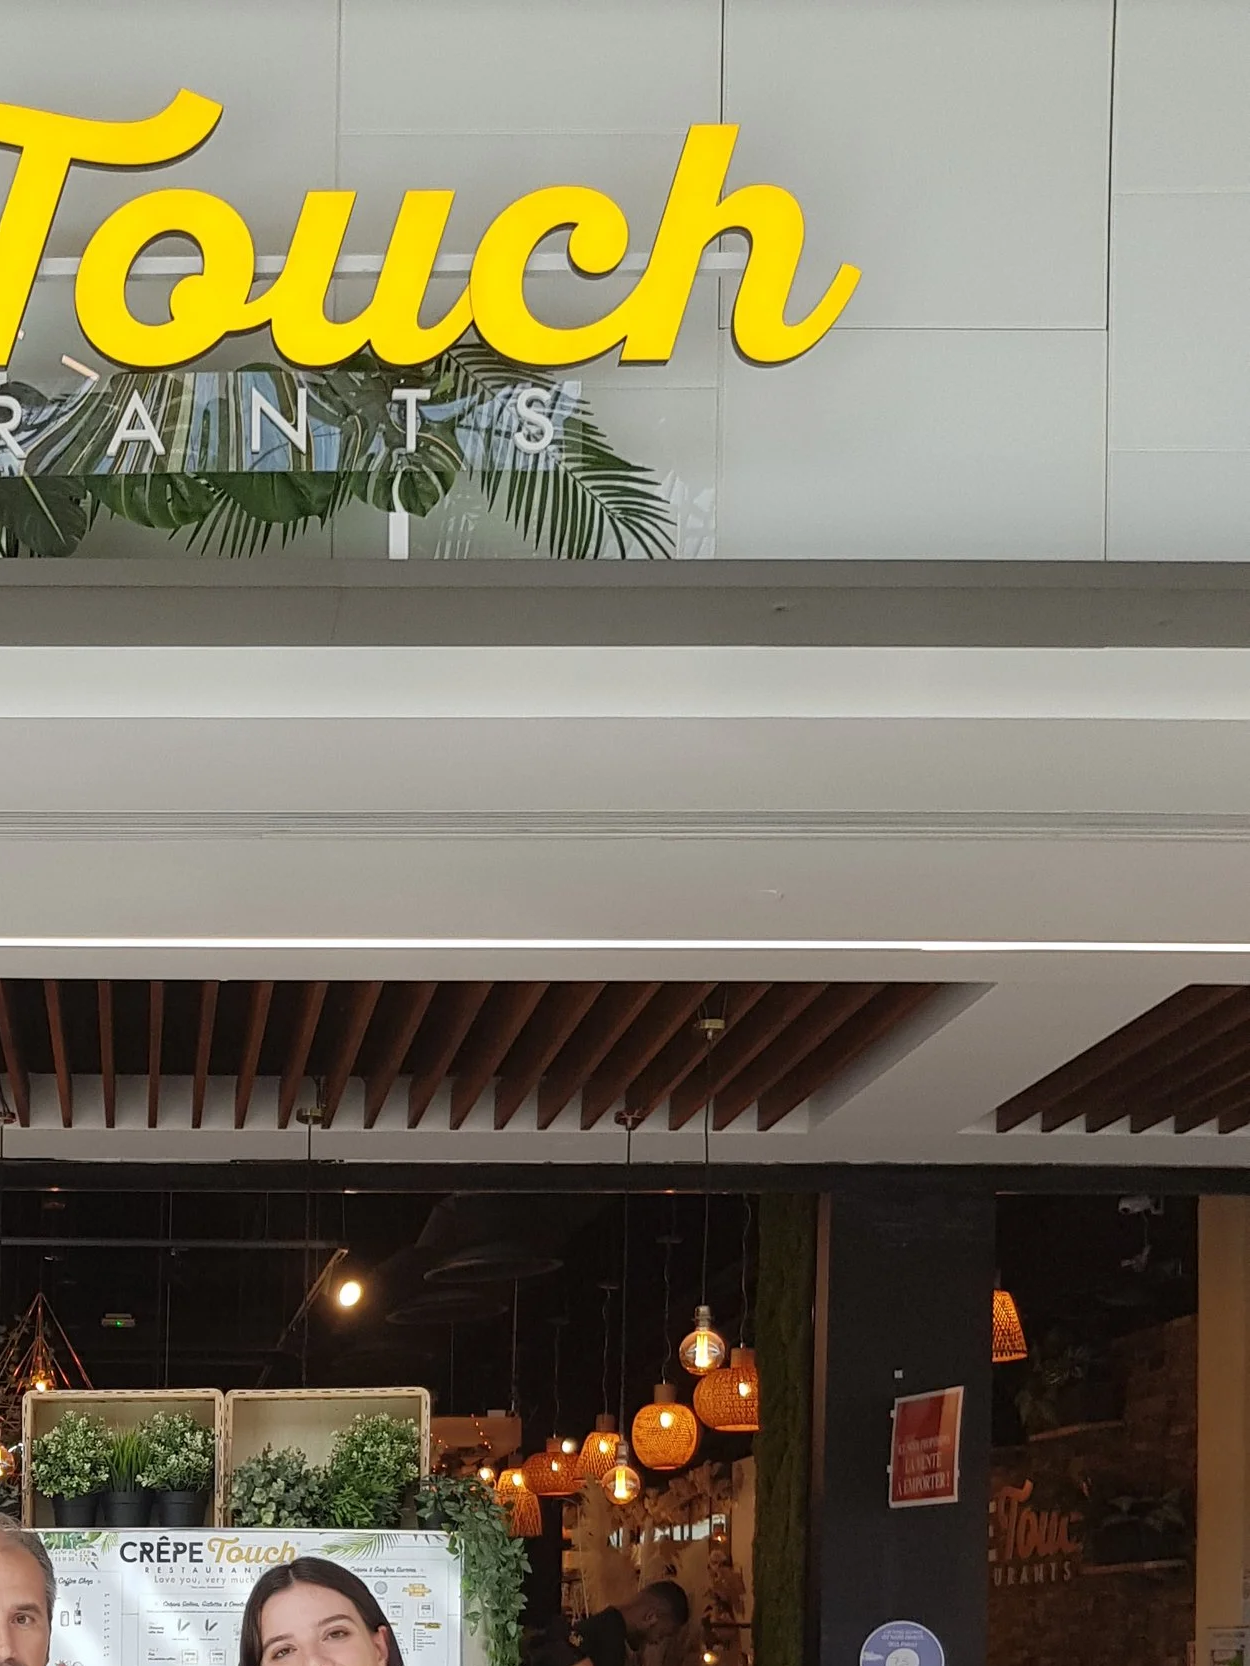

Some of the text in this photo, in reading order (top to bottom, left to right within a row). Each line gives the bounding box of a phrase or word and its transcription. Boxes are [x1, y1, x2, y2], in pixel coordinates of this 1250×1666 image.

[119, 1535, 297, 1564] CRÊPE Touch
[154, 1575, 176, 1584] Love
[180, 1576, 201, 1586] you,
[205, 1576, 227, 1586] very
